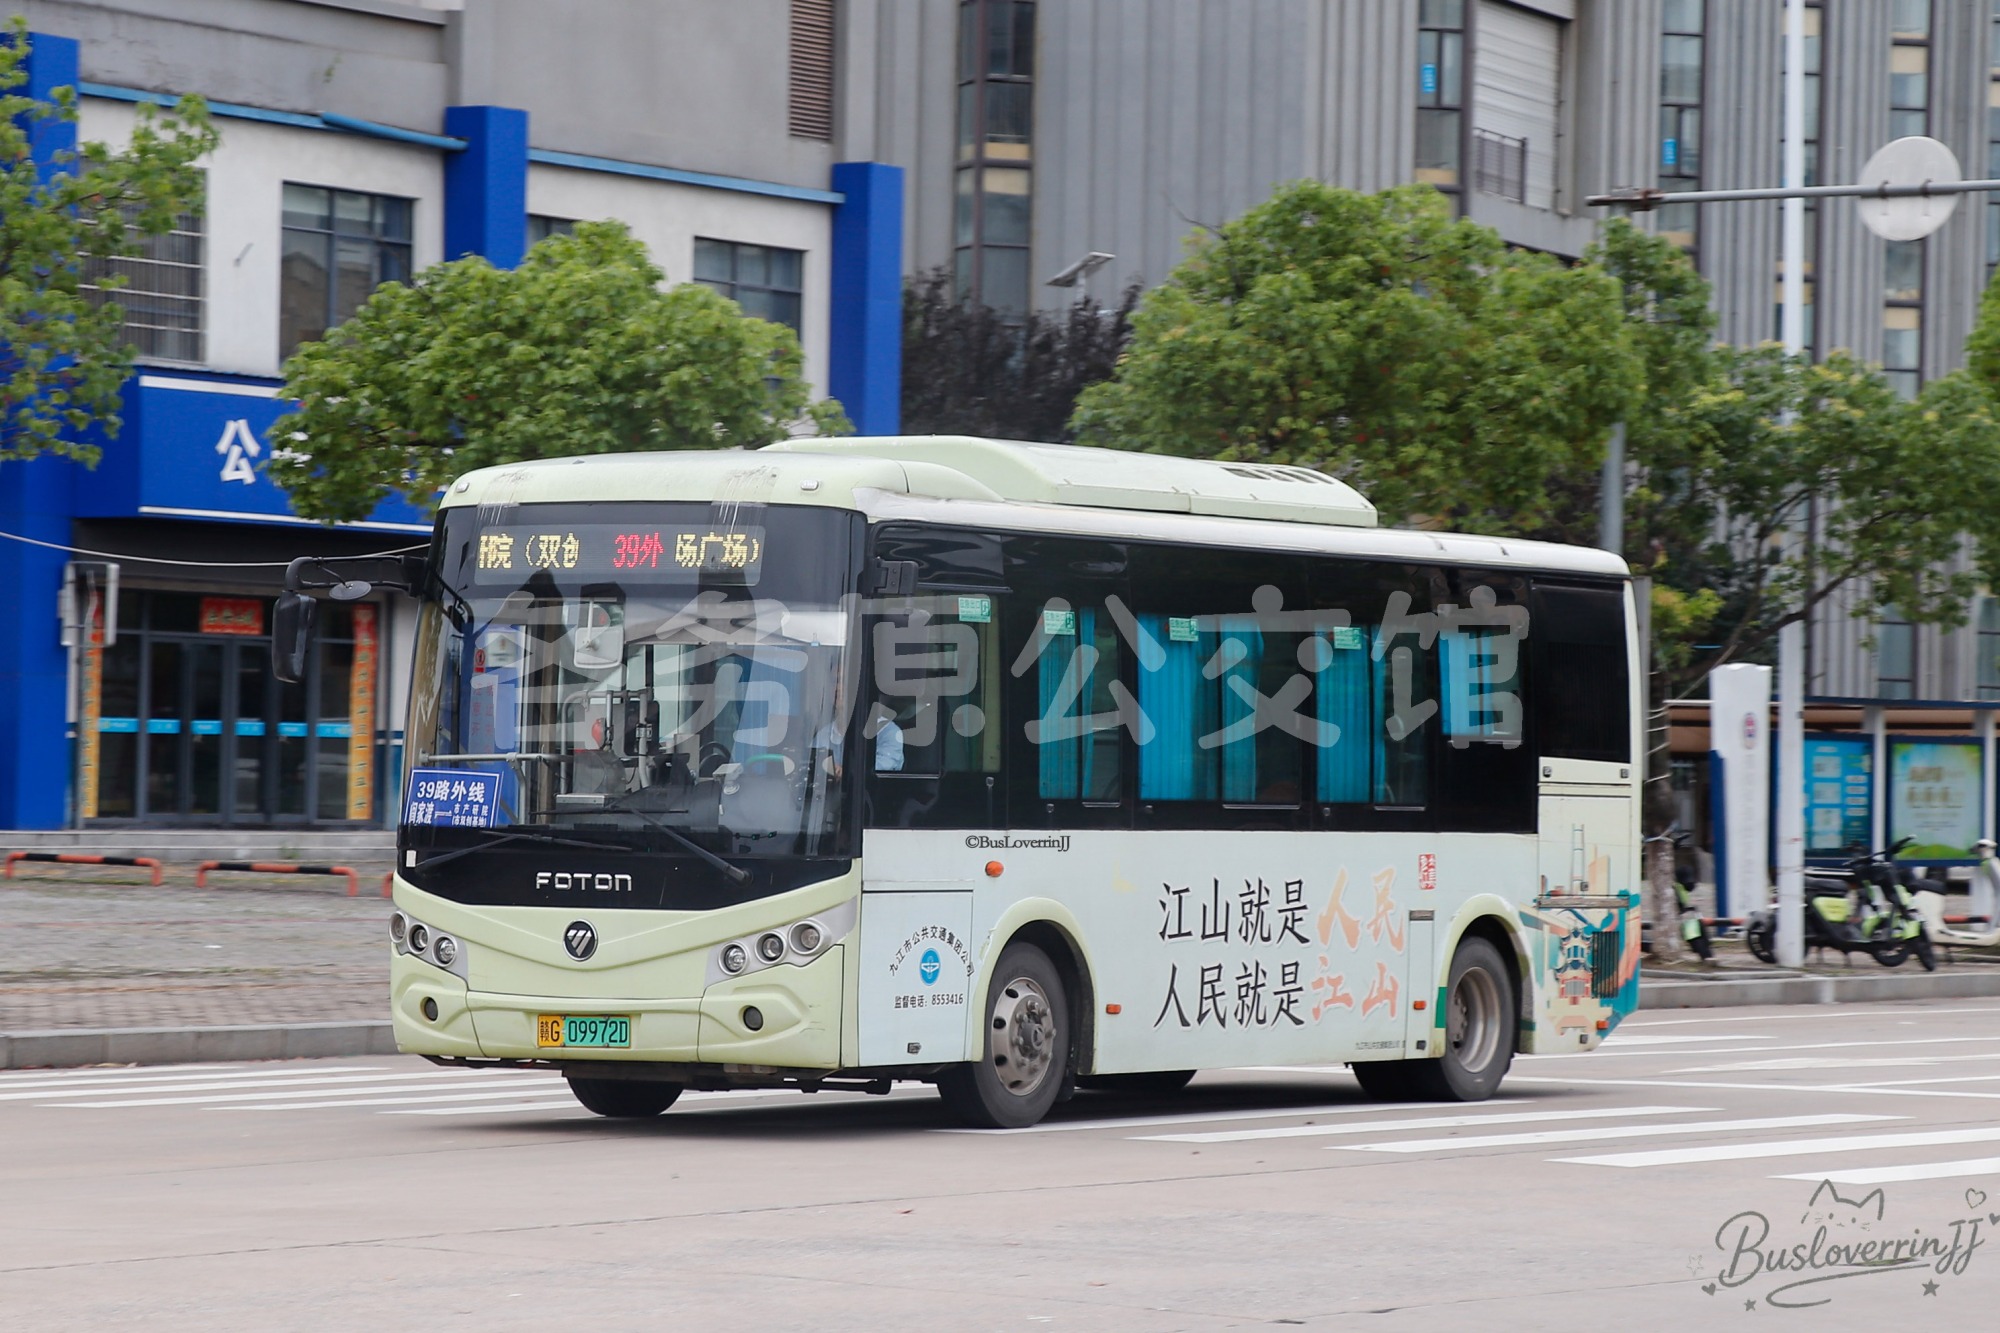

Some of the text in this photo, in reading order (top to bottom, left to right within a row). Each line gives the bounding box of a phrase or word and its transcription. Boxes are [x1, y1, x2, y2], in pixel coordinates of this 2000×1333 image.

[215, 419, 261, 485] 公
[613, 532, 664, 568] 39外
[417, 780, 485, 803] 39路外线
[536, 872, 632, 891] FOTON
[1158, 867, 1405, 952] 江山就是人民
[889, 925, 975, 977] 九江市公共交通集团公司
[1153, 956, 1400, 1029] 人民就是江山
